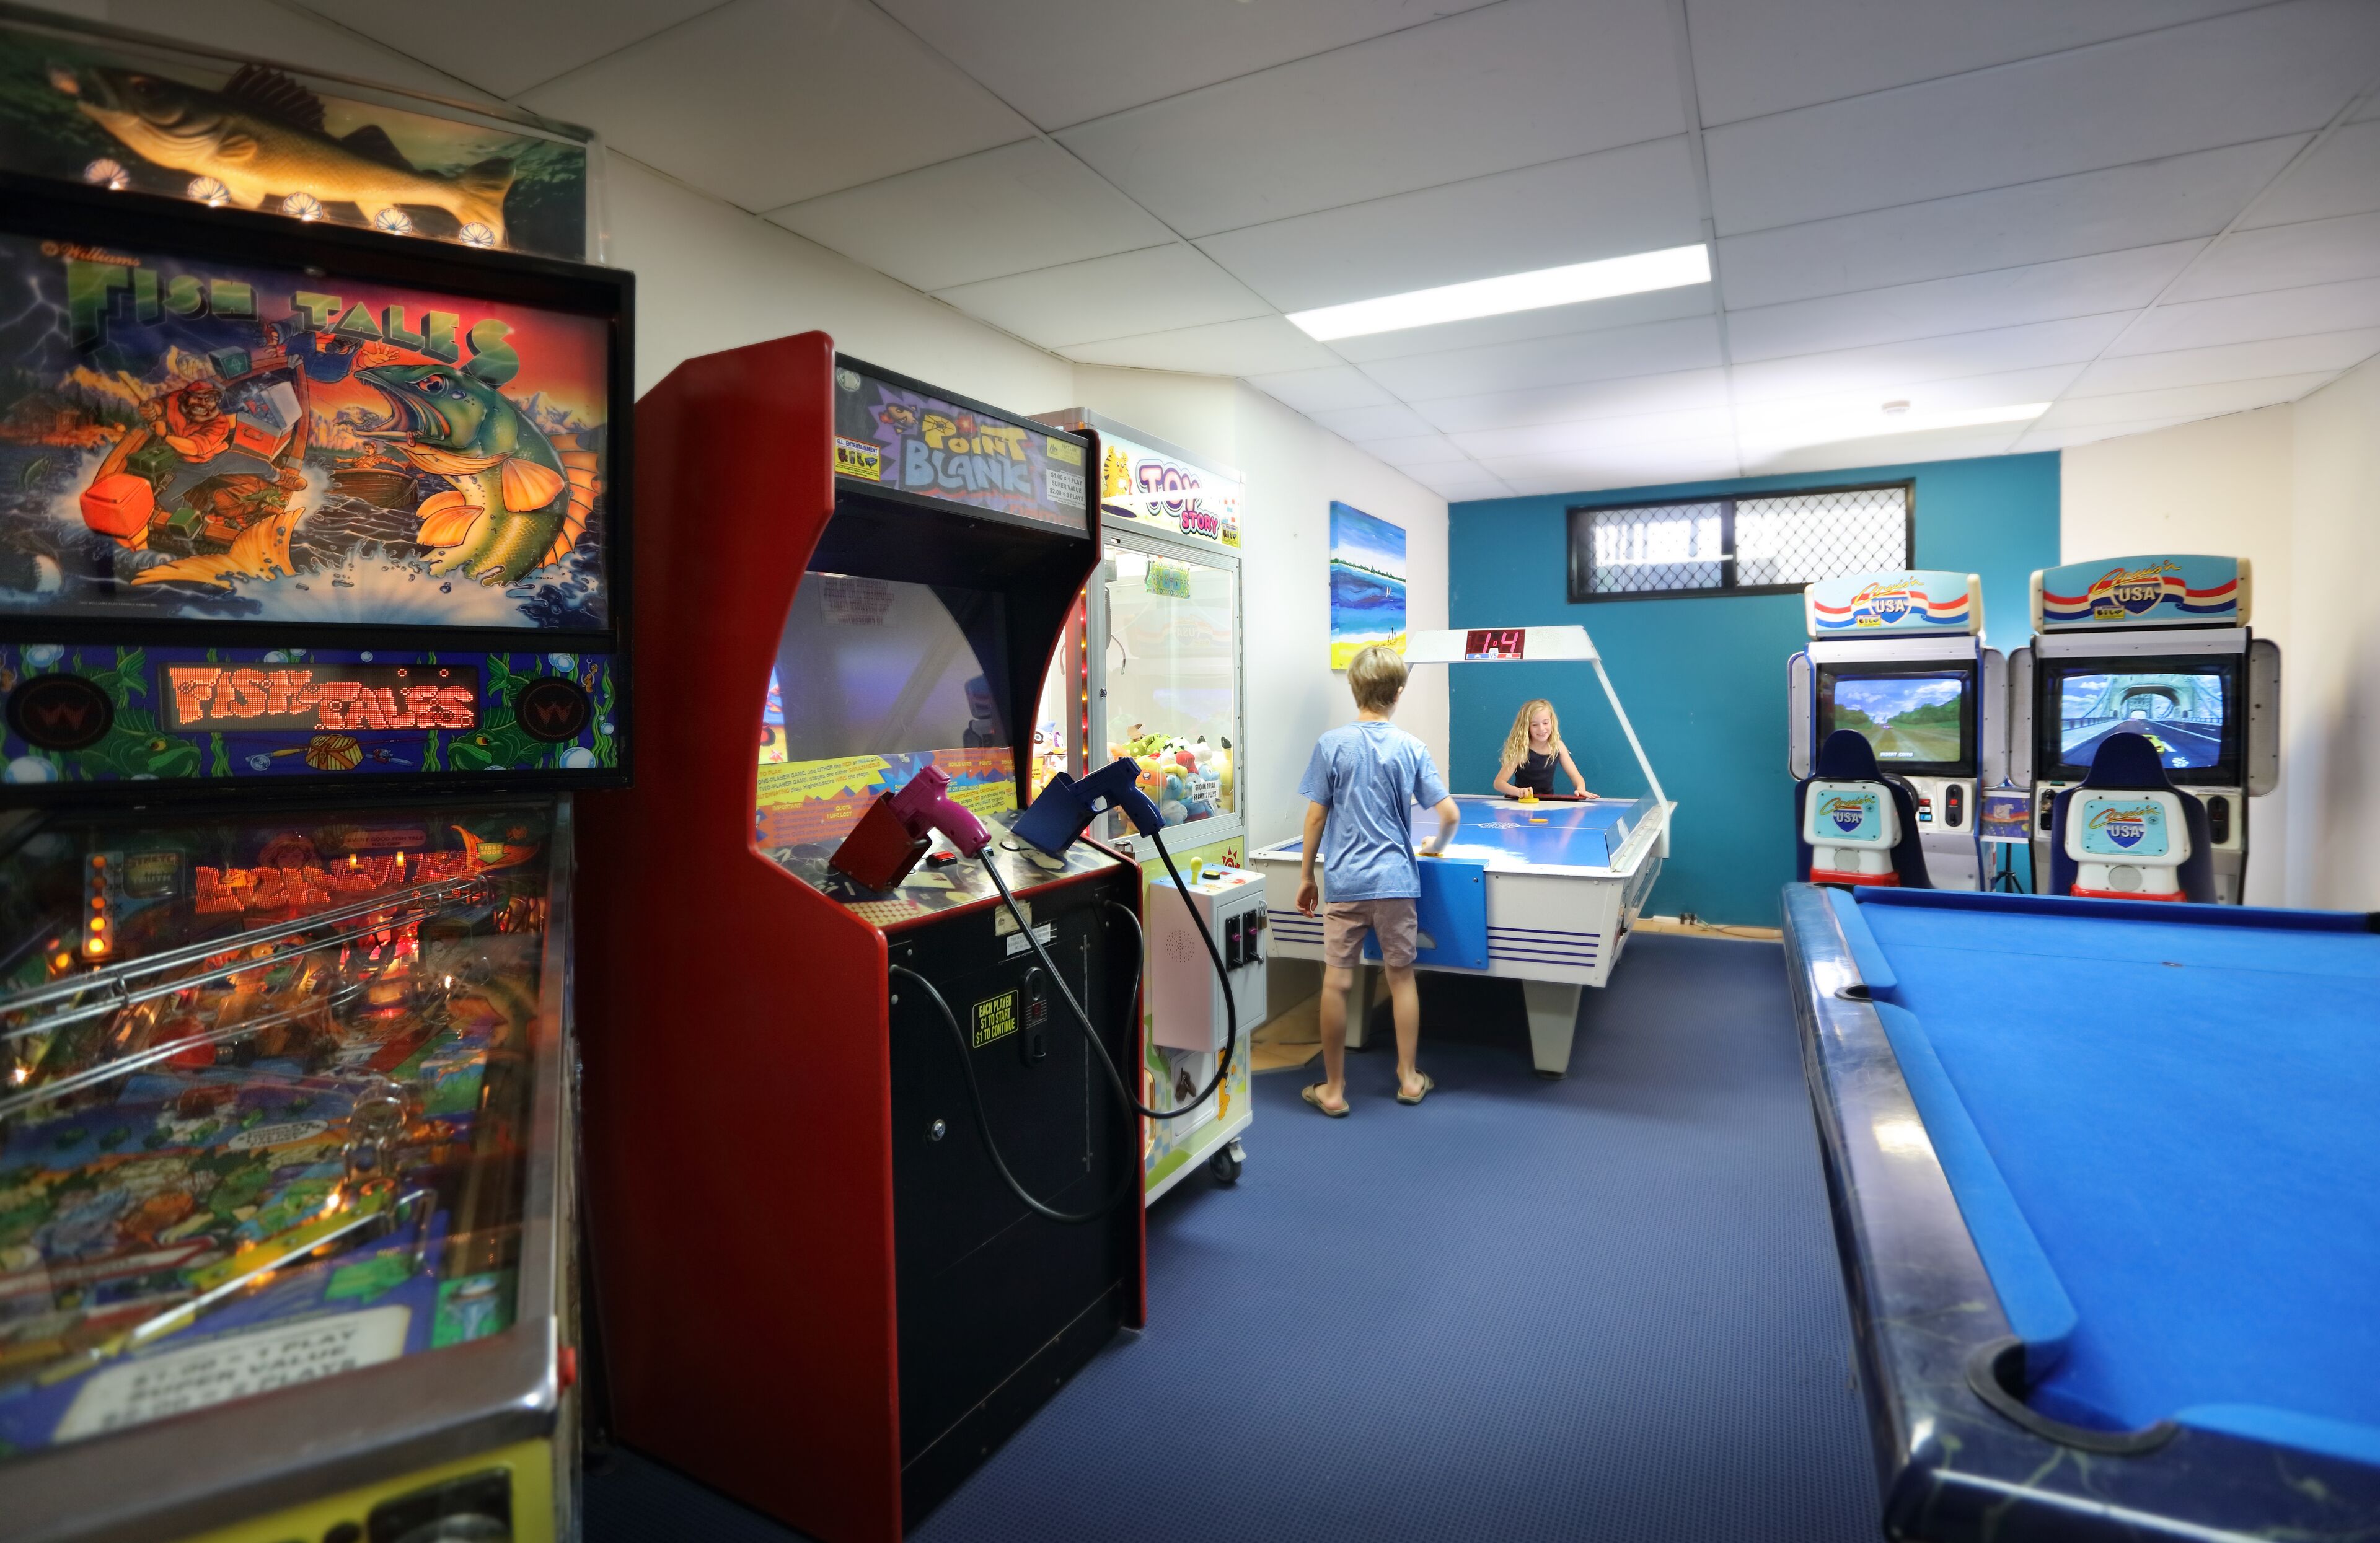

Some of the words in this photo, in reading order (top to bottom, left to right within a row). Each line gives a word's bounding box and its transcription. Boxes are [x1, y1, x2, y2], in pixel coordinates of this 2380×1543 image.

[66, 260, 258, 348] FISH
[291, 290, 519, 389] TALES
[845, 441, 878, 454] ENTERTAINMENT
[922, 413, 1030, 460] POINT
[905, 439, 1033, 493] BLANK
[1051, 472, 1063, 480] $1.00
[1071, 478, 1082, 486] PLAY
[1051, 480, 1067, 490] SUPER
[1067, 485, 1082, 494] VALUE
[1139, 464, 1201, 512] TOY
[1049, 487, 1062, 496] $2.00
[1070, 493, 1084, 502] PLAYS
[1181, 511, 1219, 535] STORY
[2092, 560, 2182, 595] Cruis'n
[1854, 576, 1924, 606] Cruis'n
[2119, 587, 2157, 602] USA
[1875, 599, 1906, 613] USA
[1501, 631, 1519, 653] 4
[168, 667, 314, 725] FISH
[306, 681, 475, 730] TALES
[757, 773, 790, 785] ONE-PLAYER
[817, 765, 833, 773] EITHER
[759, 781, 792, 792] TWO-PLAYER
[848, 762, 881, 773] SIMULTANEOUS
[757, 788, 790, 799] ALTERNATING
[954, 791, 979, 799] INSTRUCTIONS
[1836, 812, 1860, 824] USA
[2089, 805, 2161, 829] Cruis'n
[2111, 825, 2141, 837] USA
[979, 1001, 992, 1018] EACH
[993, 994, 1012, 1013] PLAYER
[981, 1016, 987, 1030] $1
[988, 1013, 995, 1027] TO
[995, 1006, 1011, 1024] START
[976, 1031, 982, 1045] $1
[984, 1027, 990, 1041] TO
[991, 1018, 1015, 1038] CONTINUE
[283, 1329, 356, 1353] PLAY
[131, 1369, 236, 1402] SUPER
[249, 1345, 348, 1375] VALUE
